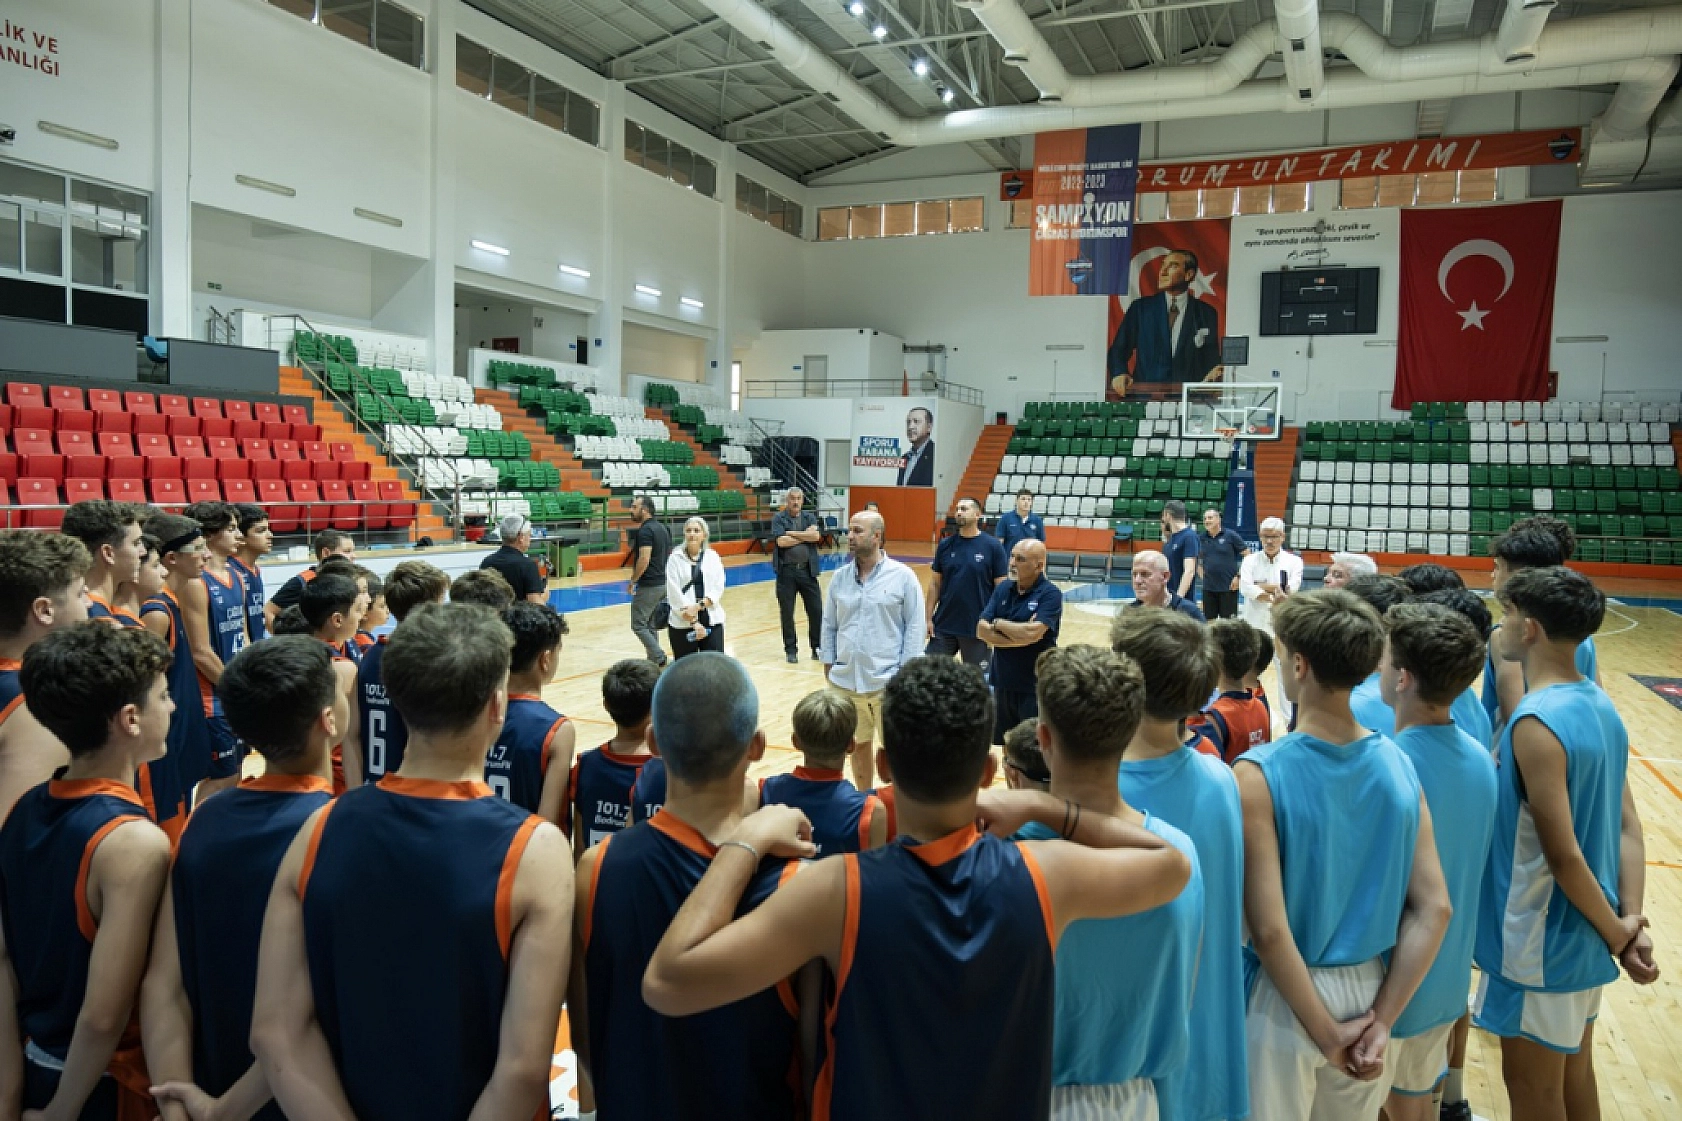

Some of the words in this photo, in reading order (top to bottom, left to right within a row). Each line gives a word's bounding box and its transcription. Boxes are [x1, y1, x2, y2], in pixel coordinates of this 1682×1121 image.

[0, 18, 25, 44] İK
[32, 30, 57, 54] VE
[1318, 139, 1482, 176] TAKIMI
[1061, 174, 1105, 189] 2022-2023
[861, 447, 897, 457] TABANA
[862, 438, 893, 447] SPORU
[369, 709, 387, 775] 6
